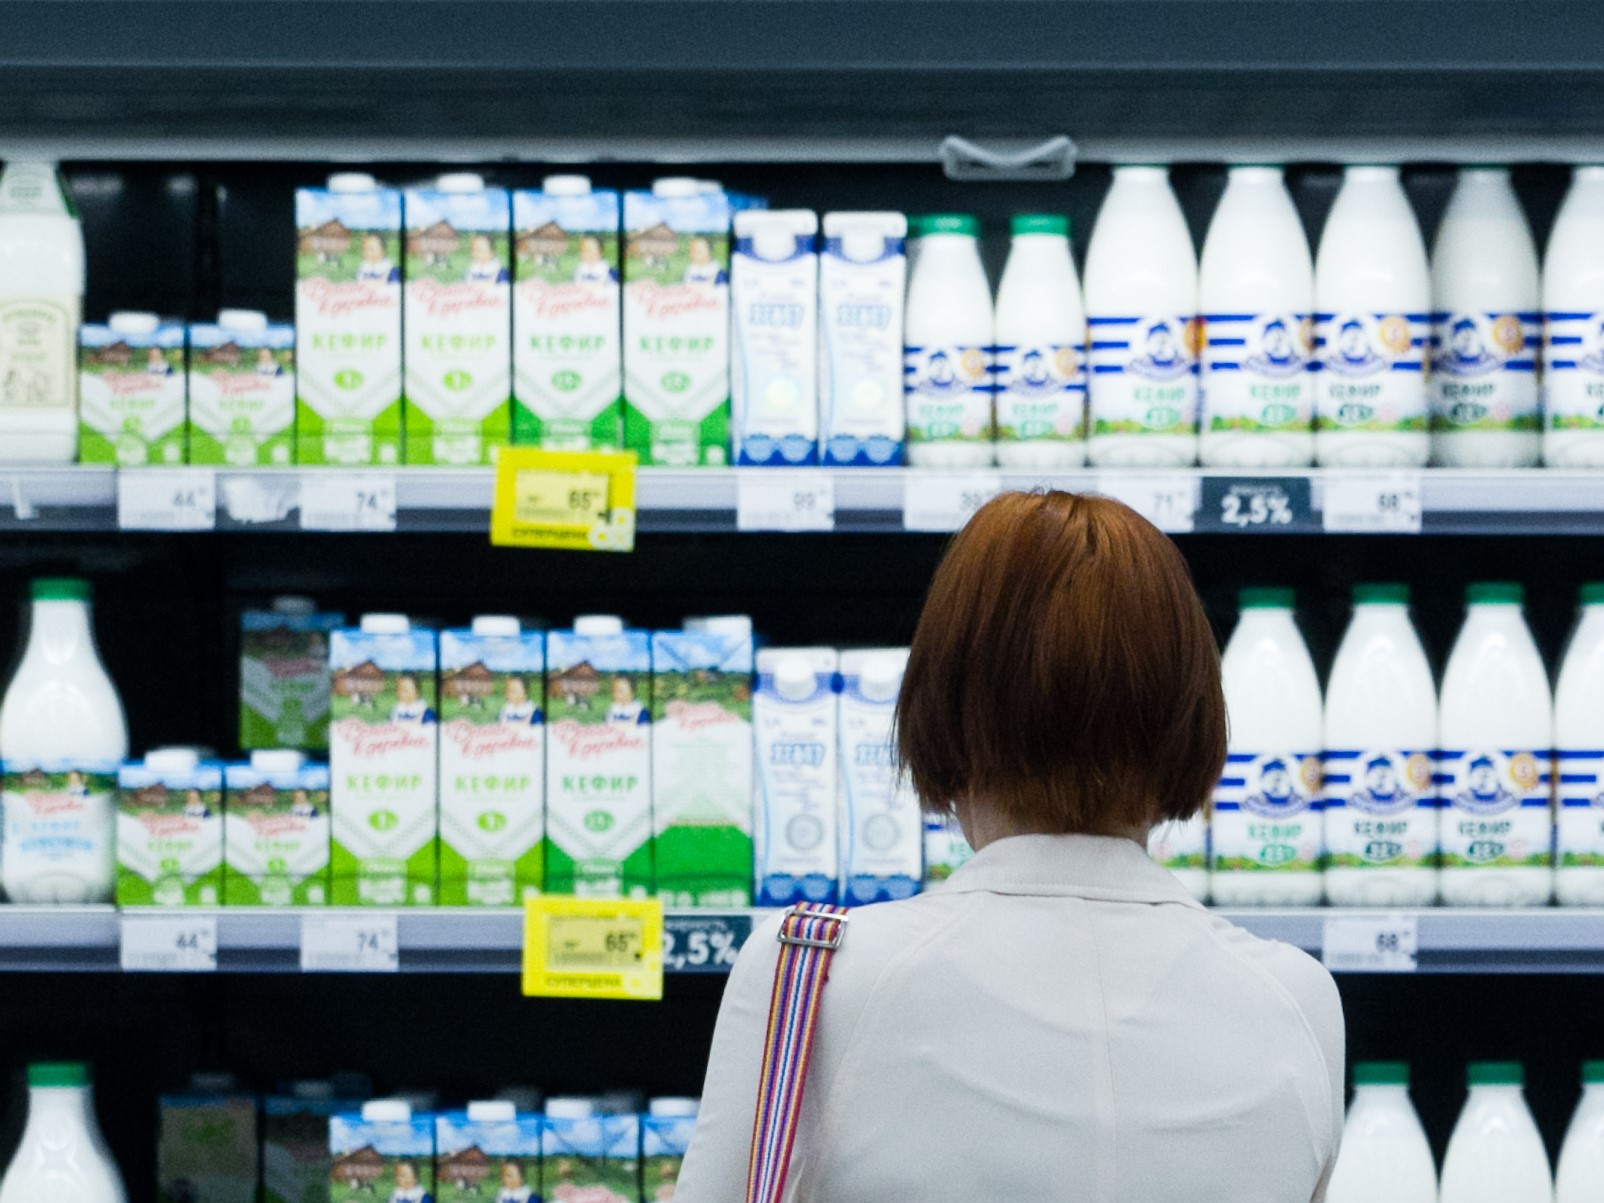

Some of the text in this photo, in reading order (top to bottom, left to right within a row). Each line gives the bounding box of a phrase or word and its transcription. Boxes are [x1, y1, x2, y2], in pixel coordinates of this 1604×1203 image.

[530, 335, 606, 352] КЕФИР
[1221, 494, 1292, 526] 2,5%
[347, 774, 421, 791] КЕФИР
[455, 774, 530, 791] КЕФИР
[563, 775, 638, 792] КЕФИР
[605, 933, 629, 952] 65
[661, 931, 738, 970] 2,5%
